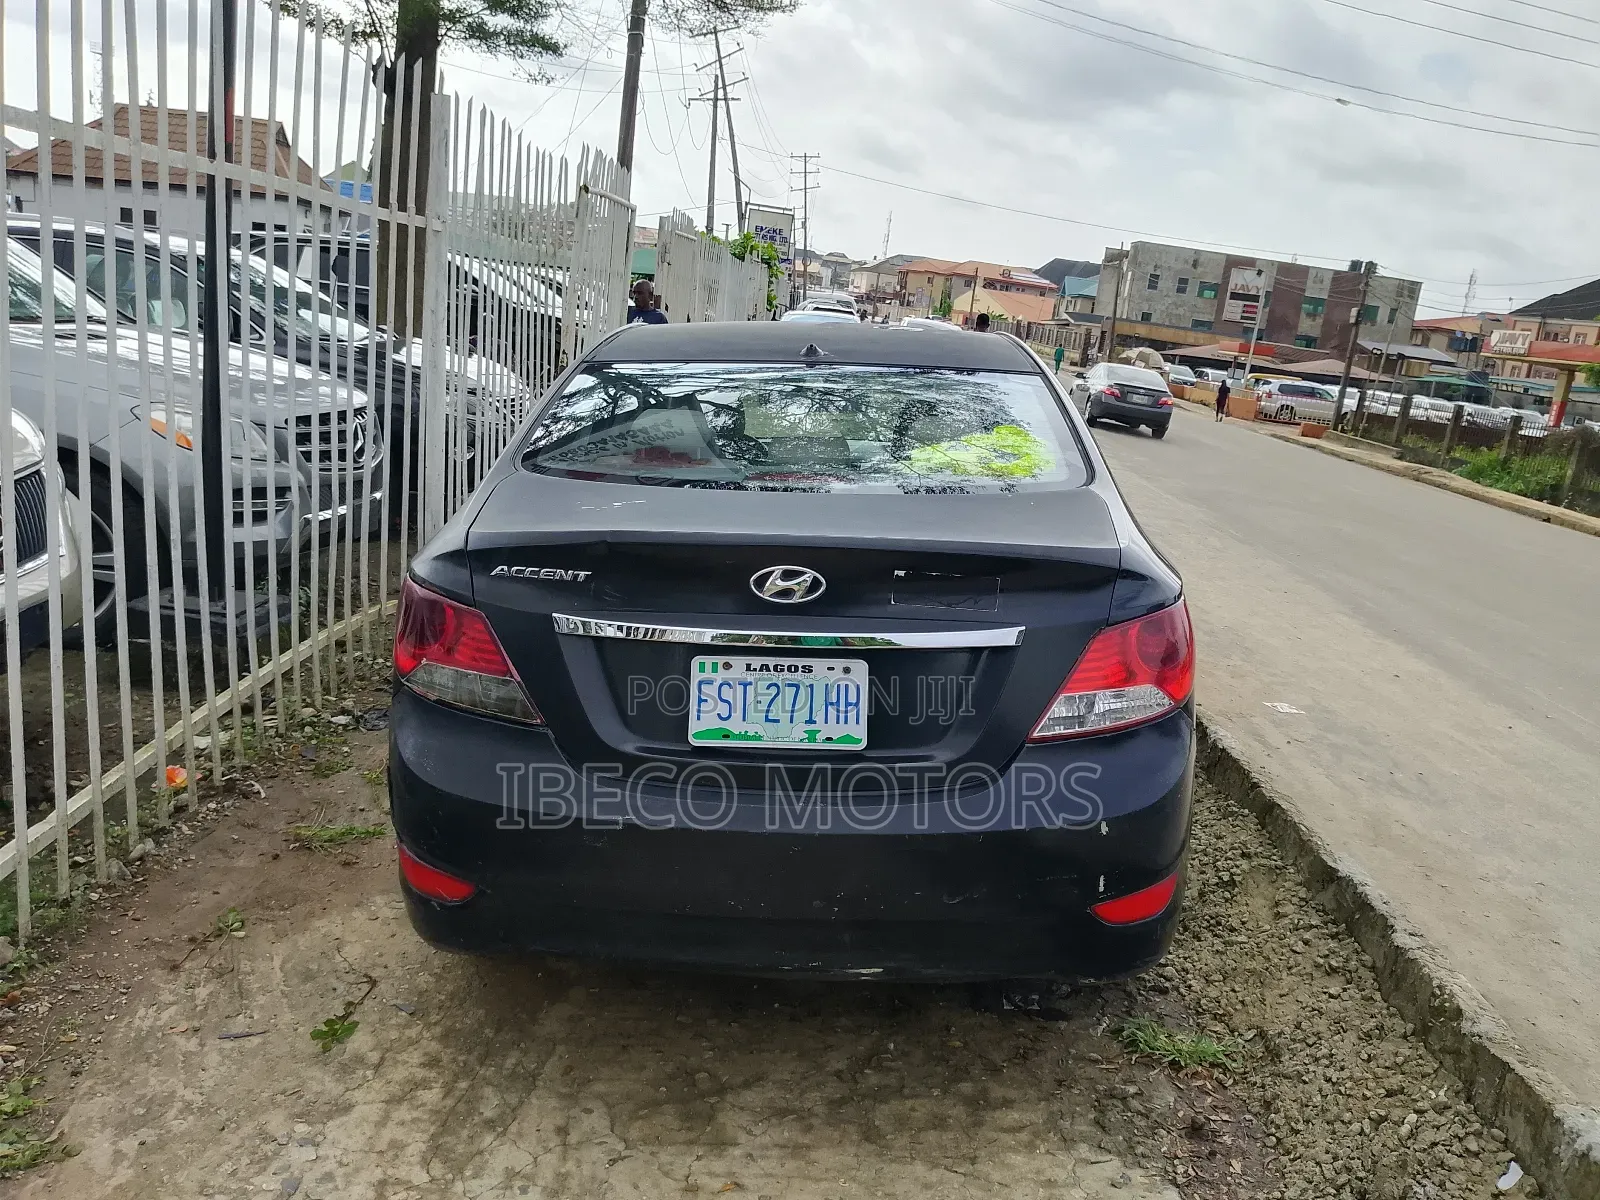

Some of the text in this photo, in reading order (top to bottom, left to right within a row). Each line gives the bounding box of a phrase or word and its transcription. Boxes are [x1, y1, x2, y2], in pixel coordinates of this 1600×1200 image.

[1230, 283, 1262, 294] JAVY
[490, 565, 592, 582] ACCENT
[745, 662, 814, 674] LAGOS
